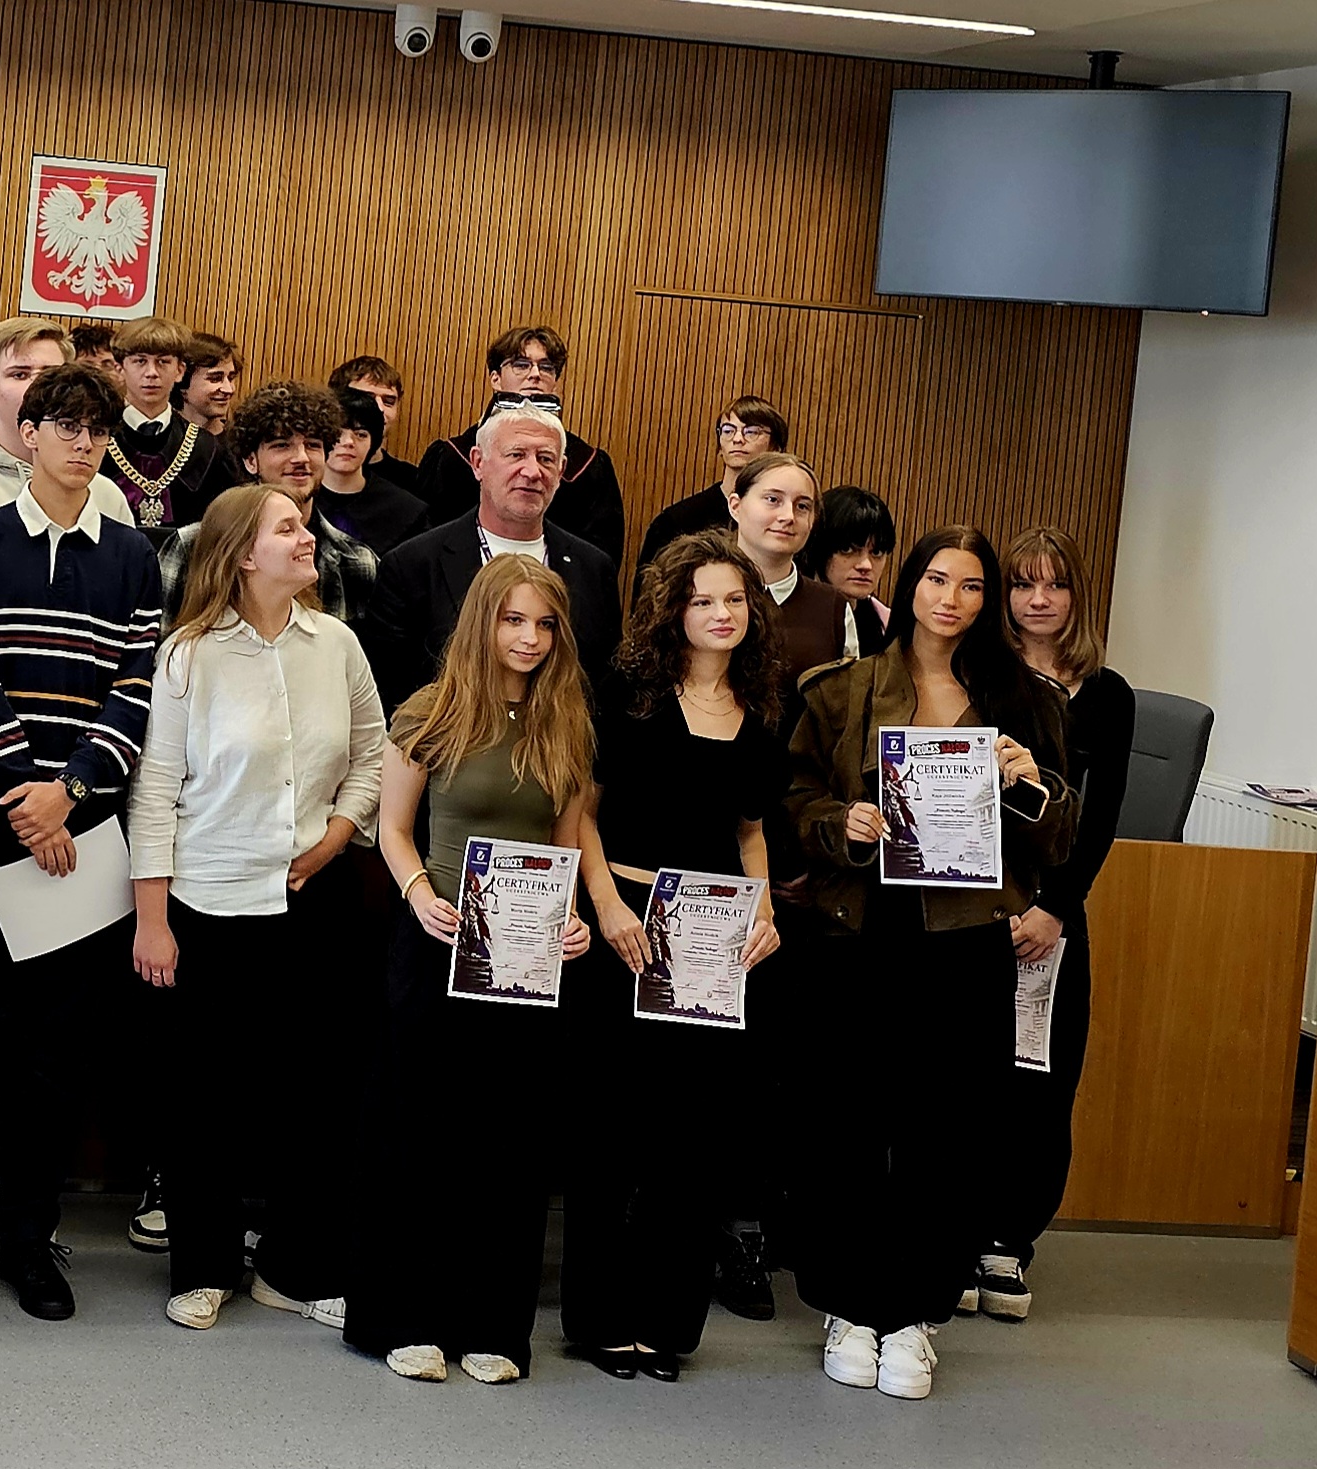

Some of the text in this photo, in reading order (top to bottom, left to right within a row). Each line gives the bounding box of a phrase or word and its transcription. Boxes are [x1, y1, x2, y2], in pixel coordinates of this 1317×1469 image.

[911, 743, 940, 755] PROCES
[916, 763, 985, 775] CERTYFIKAT
[495, 857, 523, 868] PROCES
[497, 877, 562, 893] CERTYFIKAT
[682, 886, 710, 895] PROCES
[682, 903, 745, 918] CERTYFIKAT
[1017, 961, 1048, 973] FIKAT
